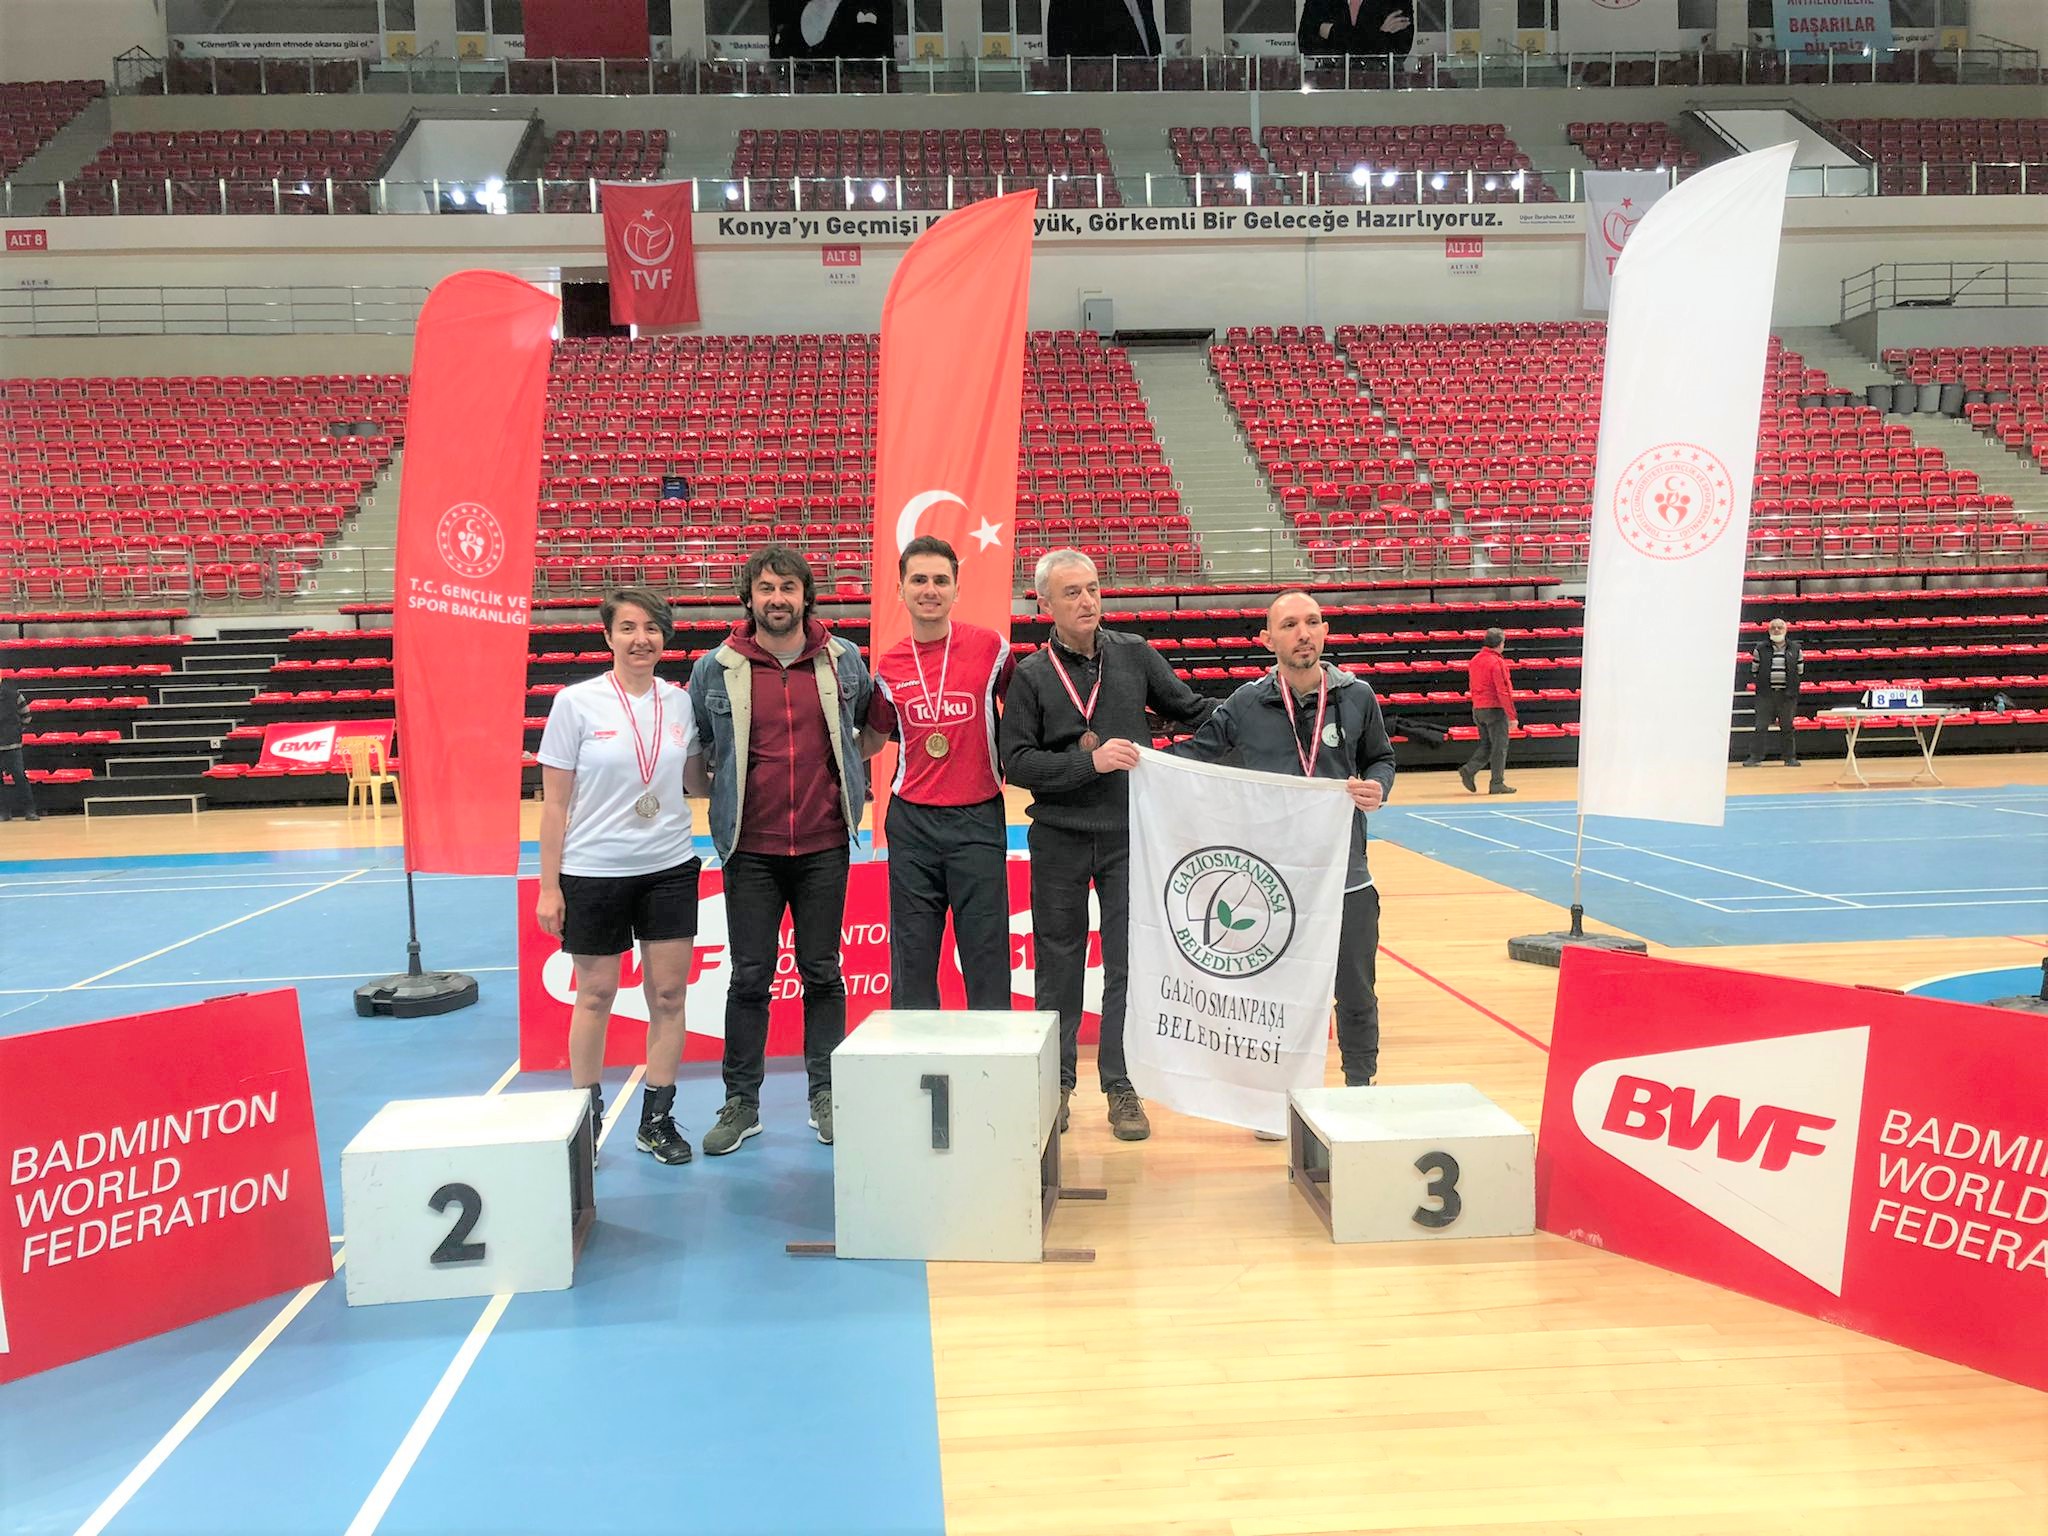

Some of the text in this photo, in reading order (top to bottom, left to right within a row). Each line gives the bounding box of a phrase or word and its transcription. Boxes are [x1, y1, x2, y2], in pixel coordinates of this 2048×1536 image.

[1790, 17, 1875, 37] BAŞARILAR
[10, 234, 43, 246] ALT 8
[718, 217, 819, 239] Konya'yı
[826, 215, 919, 237] Geçmişi
[1034, 209, 1503, 235] yük, Görkemli Bir Geleceğe Hazırlıyoruz.
[826, 249, 857, 262] ALT 9
[1448, 242, 1481, 253] ALT 10
[630, 269, 673, 291] TVF
[408, 596, 526, 625] SPOR BAKANLIĞI
[409, 578, 527, 609] T.C. GENÇLİK VE
[913, 700, 967, 720] Toku
[1877, 694, 1885, 705] 8
[1910, 693, 1919, 704] 4
[279, 740, 328, 753] BWF
[1173, 853, 1286, 915] GAZİOSMANPAŞA
[1176, 927, 1275, 972] BELEDİYESİ
[1161, 974, 1285, 1032] GAZİOSMANPAŞA
[1156, 1012, 1281, 1065] BELEDİYESİ
[919, 1074, 950, 1149] 1
[1601, 1074, 1836, 1172] BWF
[10, 1091, 277, 1185] BADMINTON
[1879, 1109, 2048, 1178] BADMI
[15, 1157, 181, 1229] WORLD
[1412, 1151, 1461, 1228] 3
[1878, 1153, 2048, 1226] WORLD
[22, 1169, 289, 1274] FEDERATION
[429, 1183, 487, 1264] 2
